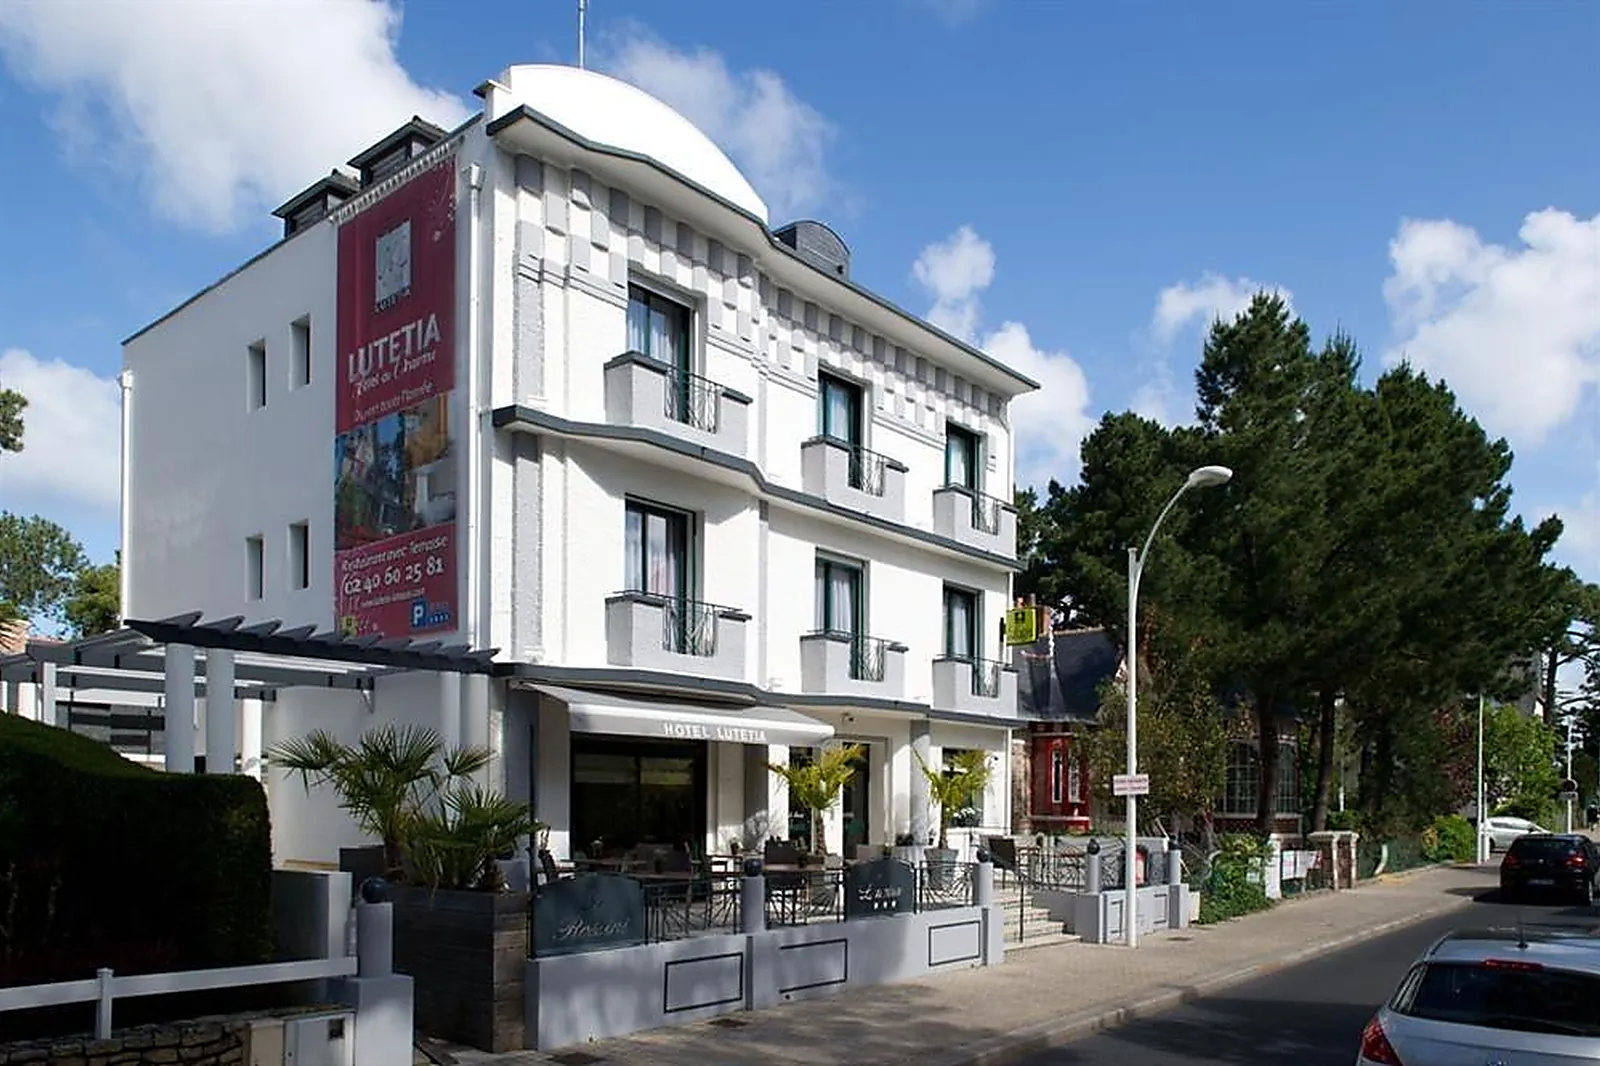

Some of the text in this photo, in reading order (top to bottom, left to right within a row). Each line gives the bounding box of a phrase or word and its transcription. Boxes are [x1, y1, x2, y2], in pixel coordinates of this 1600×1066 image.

[348, 313, 440, 384] LUTETIA
[363, 573, 380, 593] 40
[384, 565, 401, 585] 60
[405, 563, 422, 583] 25
[663, 722, 767, 742] HOTEL LUTETIA
